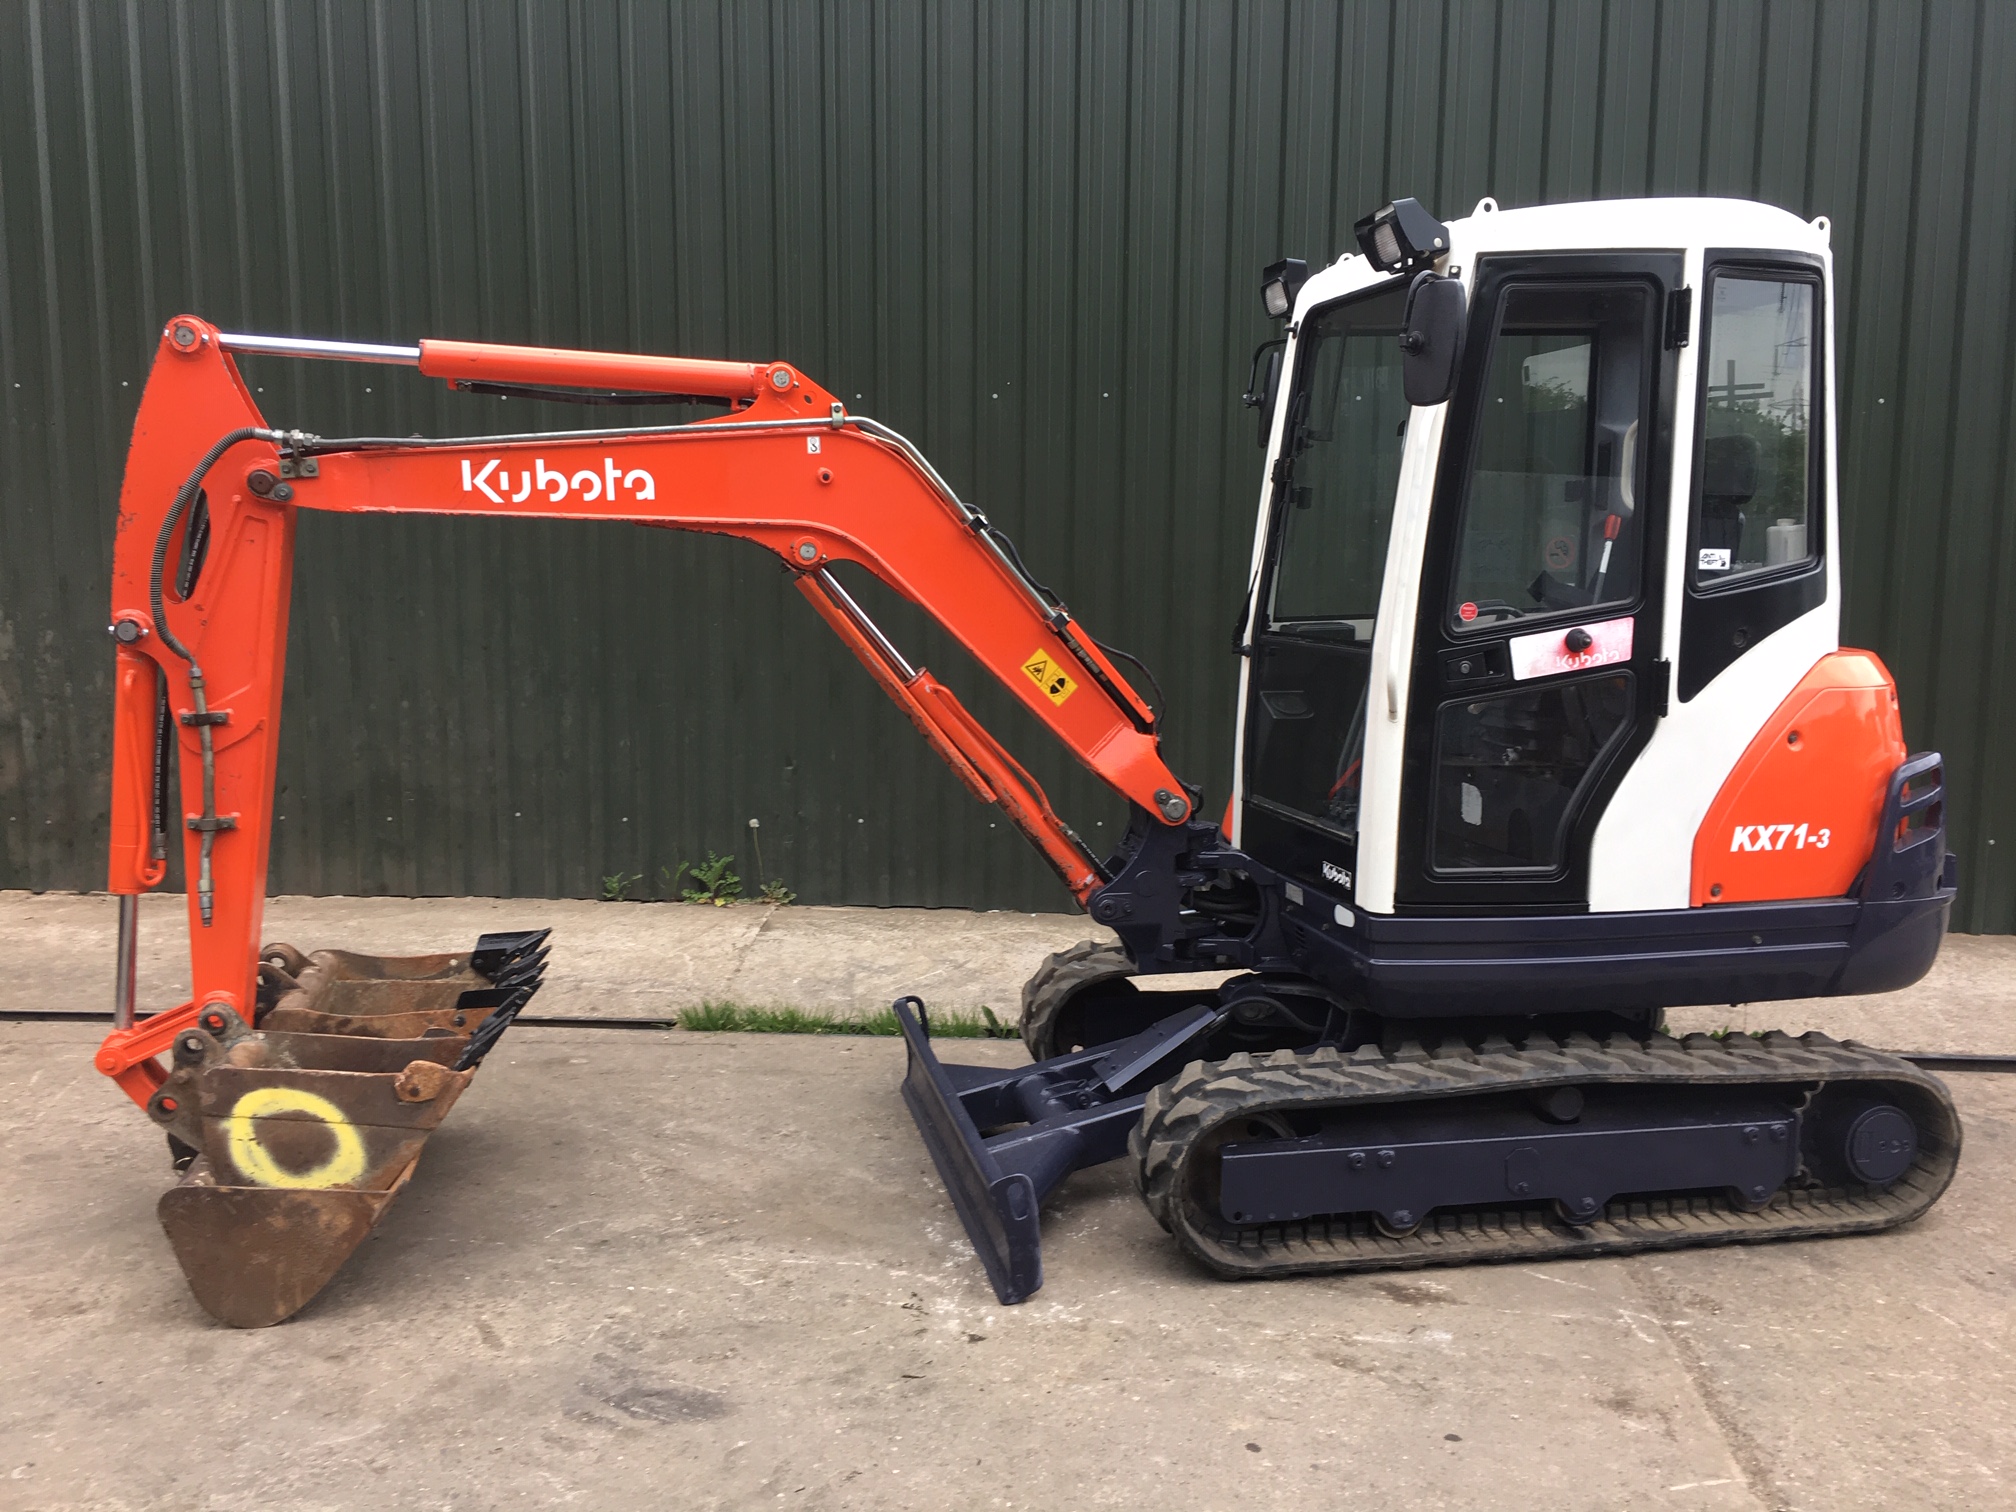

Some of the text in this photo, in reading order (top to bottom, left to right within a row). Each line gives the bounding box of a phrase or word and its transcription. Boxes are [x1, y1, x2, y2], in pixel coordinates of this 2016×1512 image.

[461, 457, 656, 504] Kubota
[1556, 648, 1620, 669] Kubota
[1730, 823, 1831, 852] KX71-3
